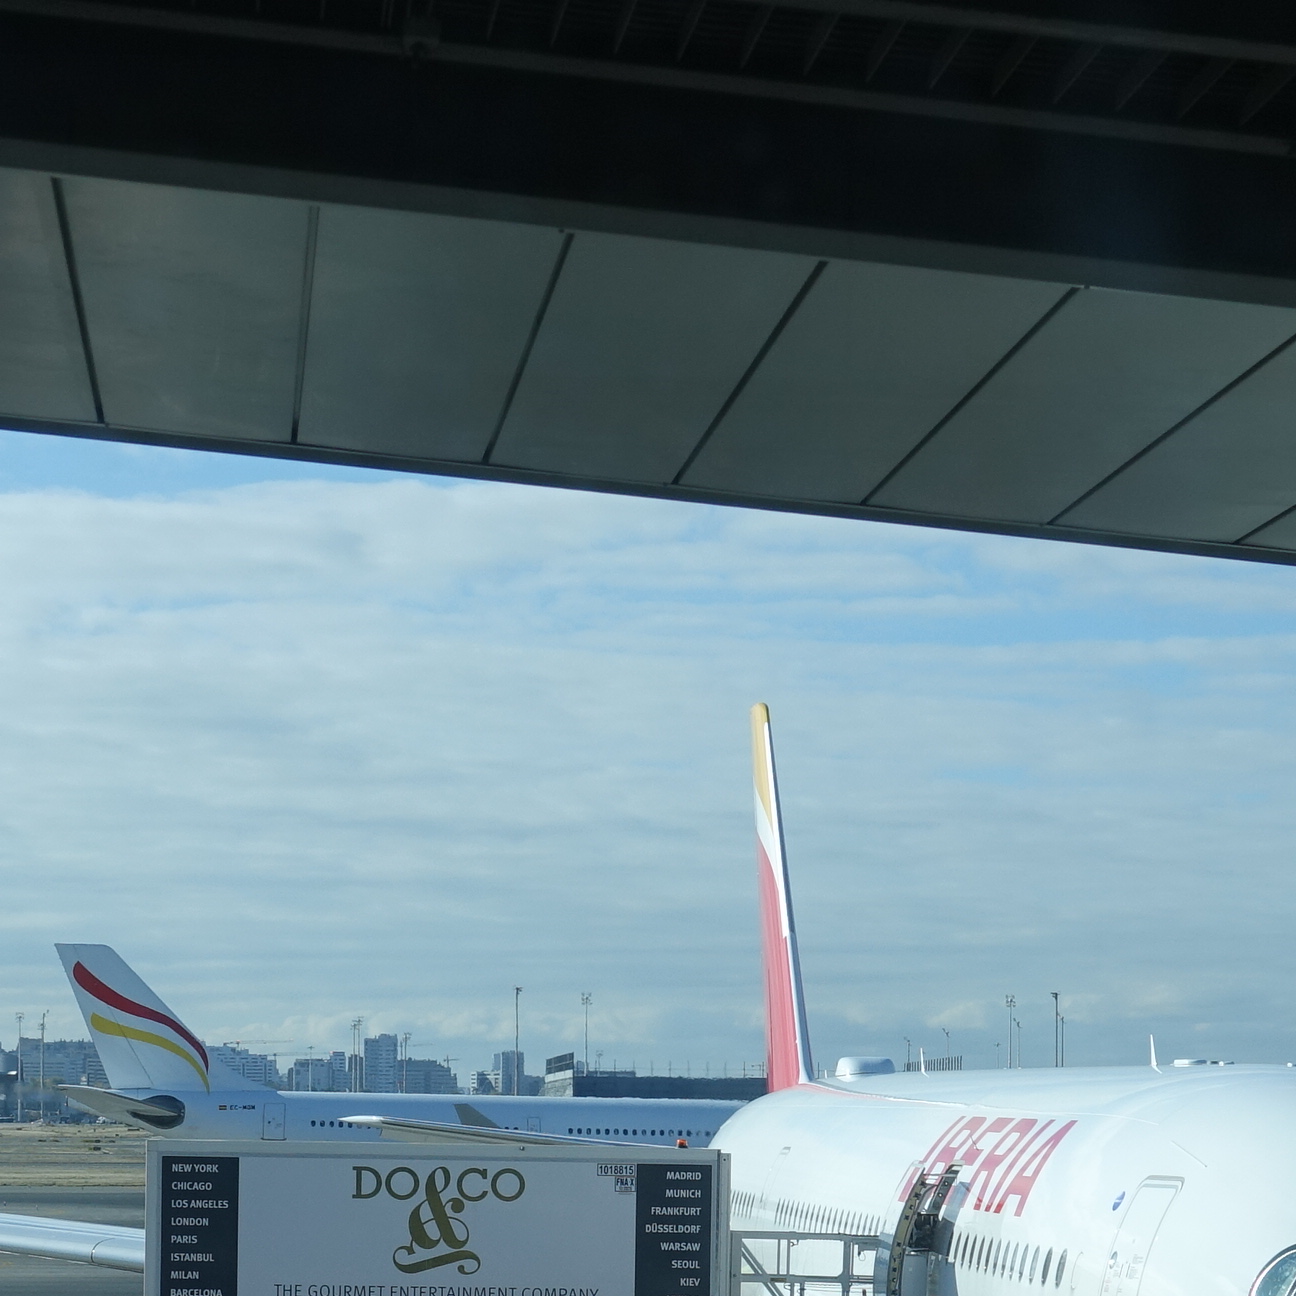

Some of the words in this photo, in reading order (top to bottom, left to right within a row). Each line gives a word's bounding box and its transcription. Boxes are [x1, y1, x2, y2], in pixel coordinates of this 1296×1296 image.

[172, 1164, 192, 1173] NEW
[193, 1164, 219, 1173] YORK
[599, 1165, 634, 1175] 1018815
[898, 1116, 1078, 1217] IBERIA
[666, 1171, 702, 1180] MADRID
[171, 1182, 212, 1191] CHICAGO
[665, 1189, 701, 1198] MUNICH
[171, 1200, 188, 1208] LOS
[190, 1200, 229, 1209] ANGELES
[651, 1206, 701, 1216] FRANKFURT
[171, 1217, 209, 1226] LONDON
[645, 1222, 701, 1234] DÜSSELDORF
[171, 1235, 198, 1244] PARIS
[660, 1242, 701, 1251] WARSAW
[170, 1253, 214, 1262] ISTANBUL
[671, 1260, 700, 1269] SEOUL
[170, 1270, 199, 1280] MILAN
[680, 1278, 700, 1286] KIEV
